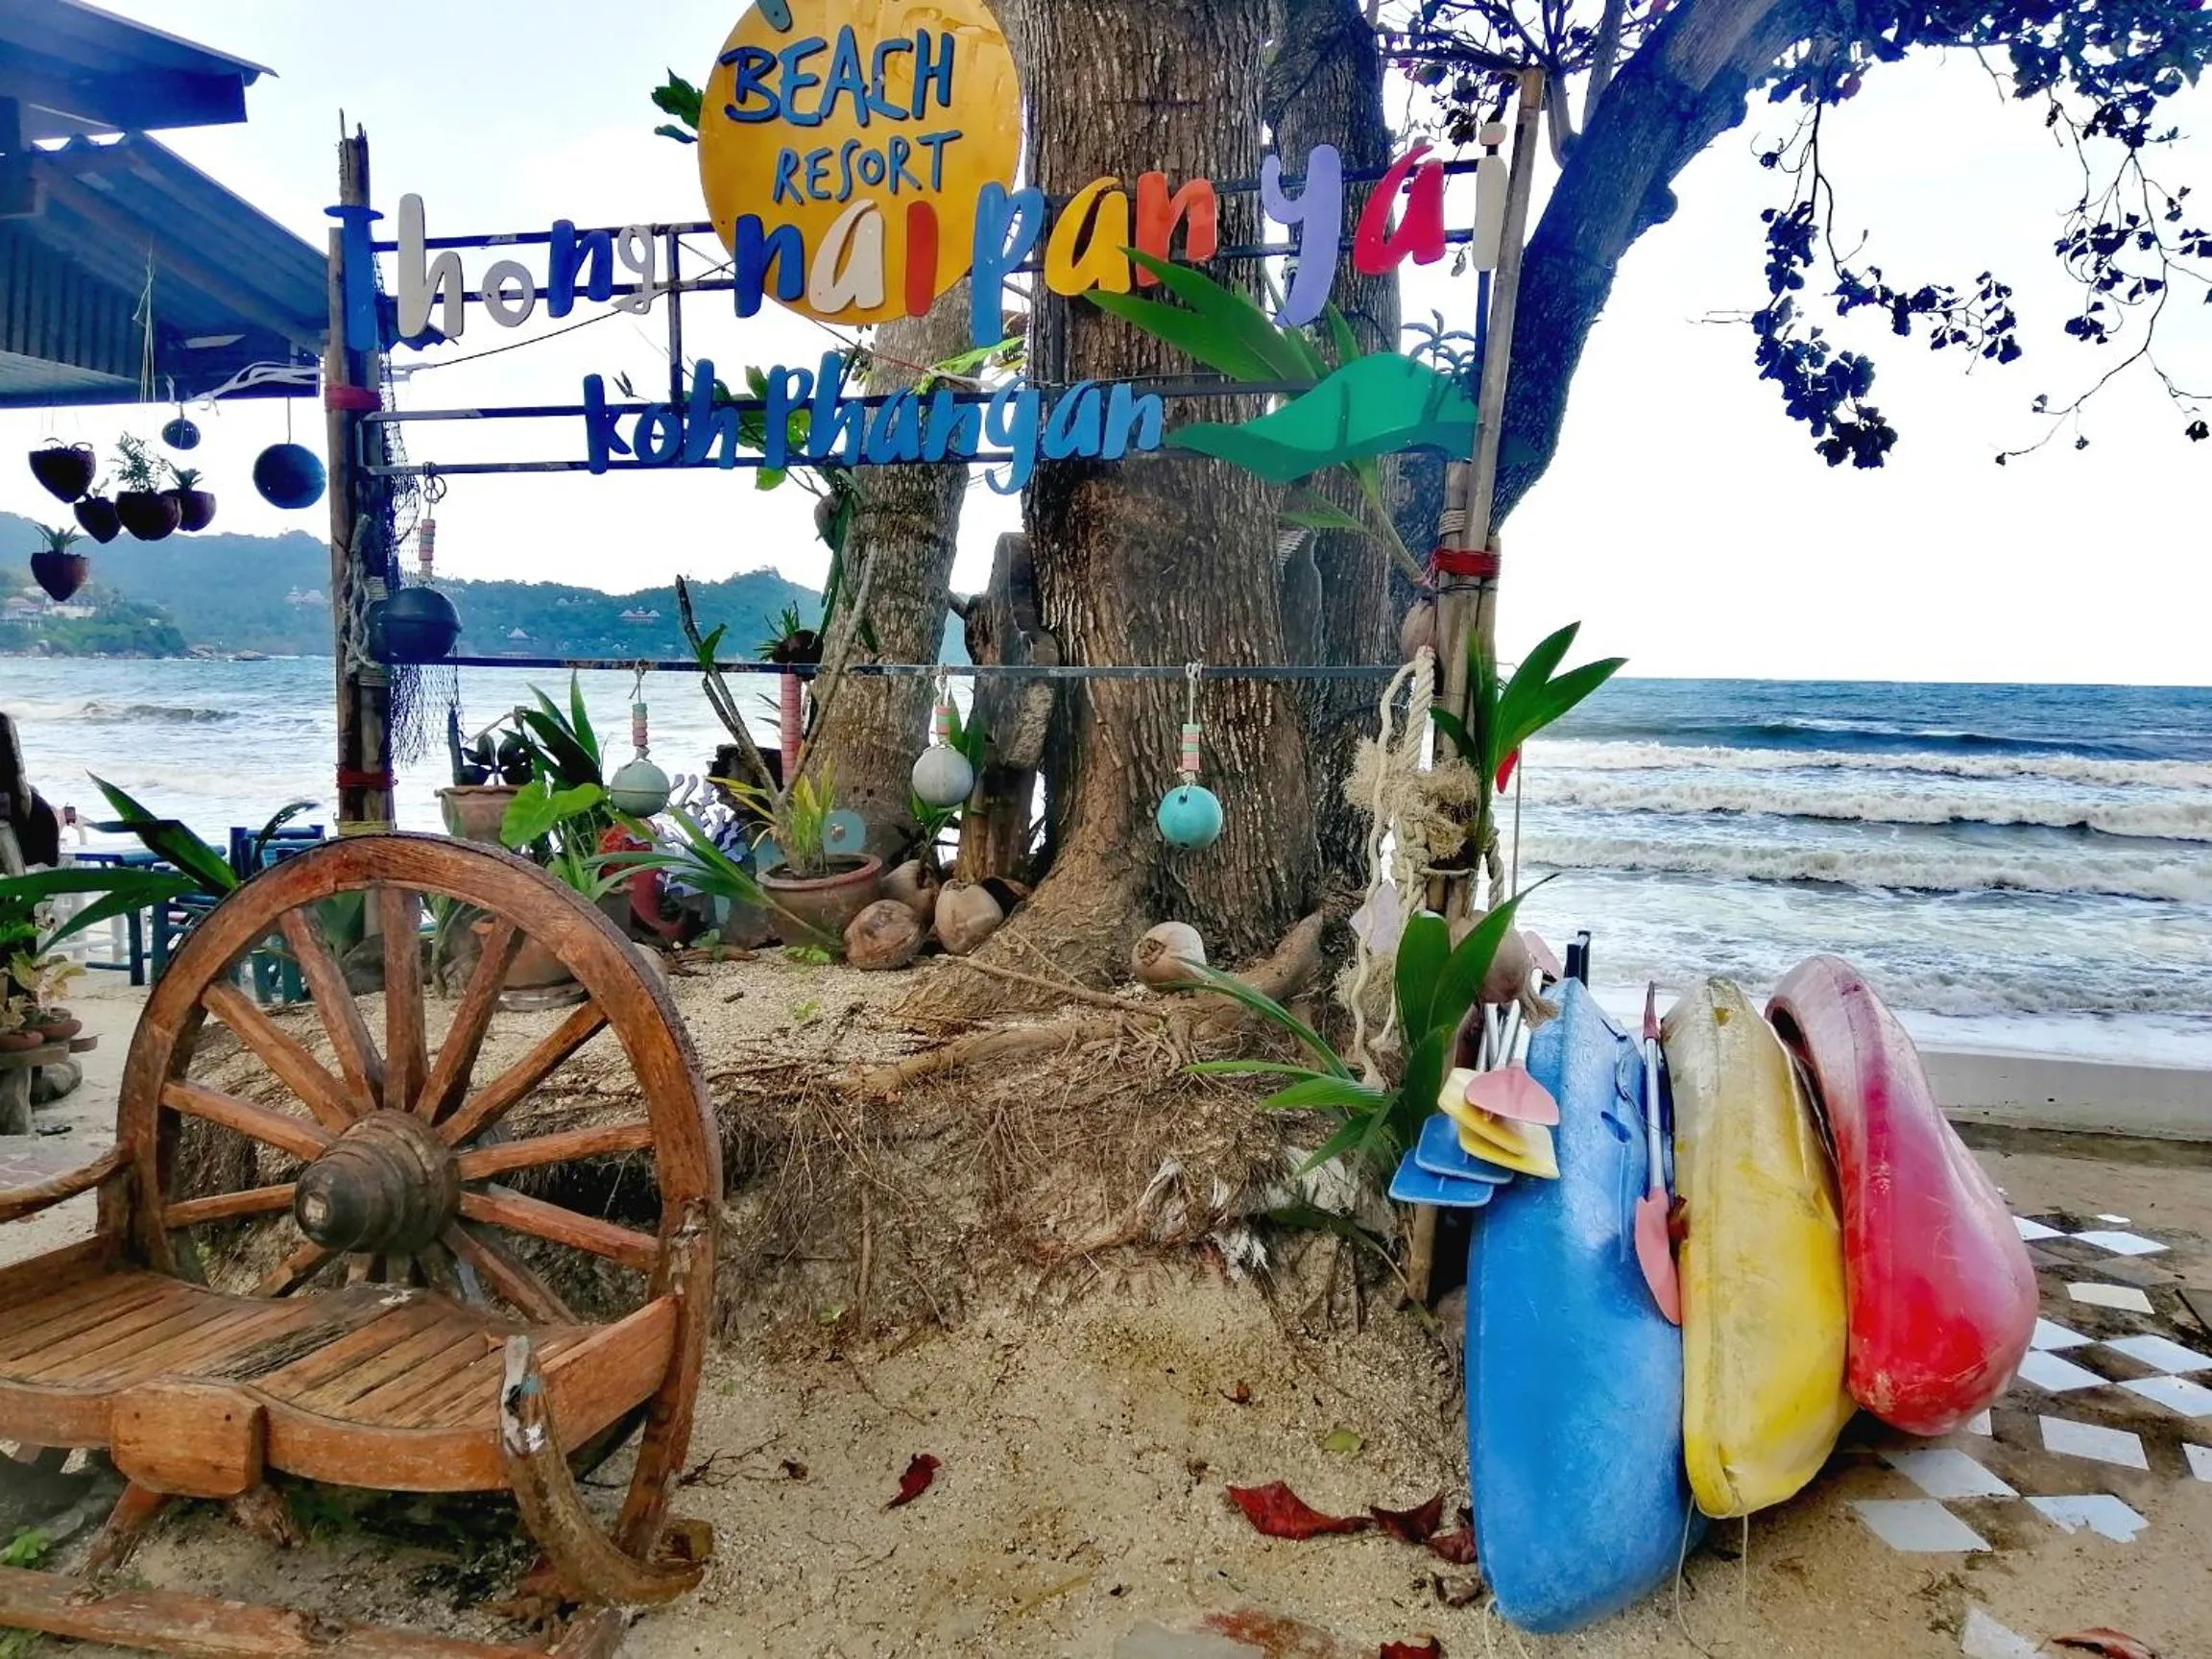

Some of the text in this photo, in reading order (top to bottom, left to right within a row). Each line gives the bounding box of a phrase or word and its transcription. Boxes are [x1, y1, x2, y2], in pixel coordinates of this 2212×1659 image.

[719, 24, 955, 128] BEACH
[772, 130, 963, 205] RESORT
[1261, 122, 1508, 327] yai
